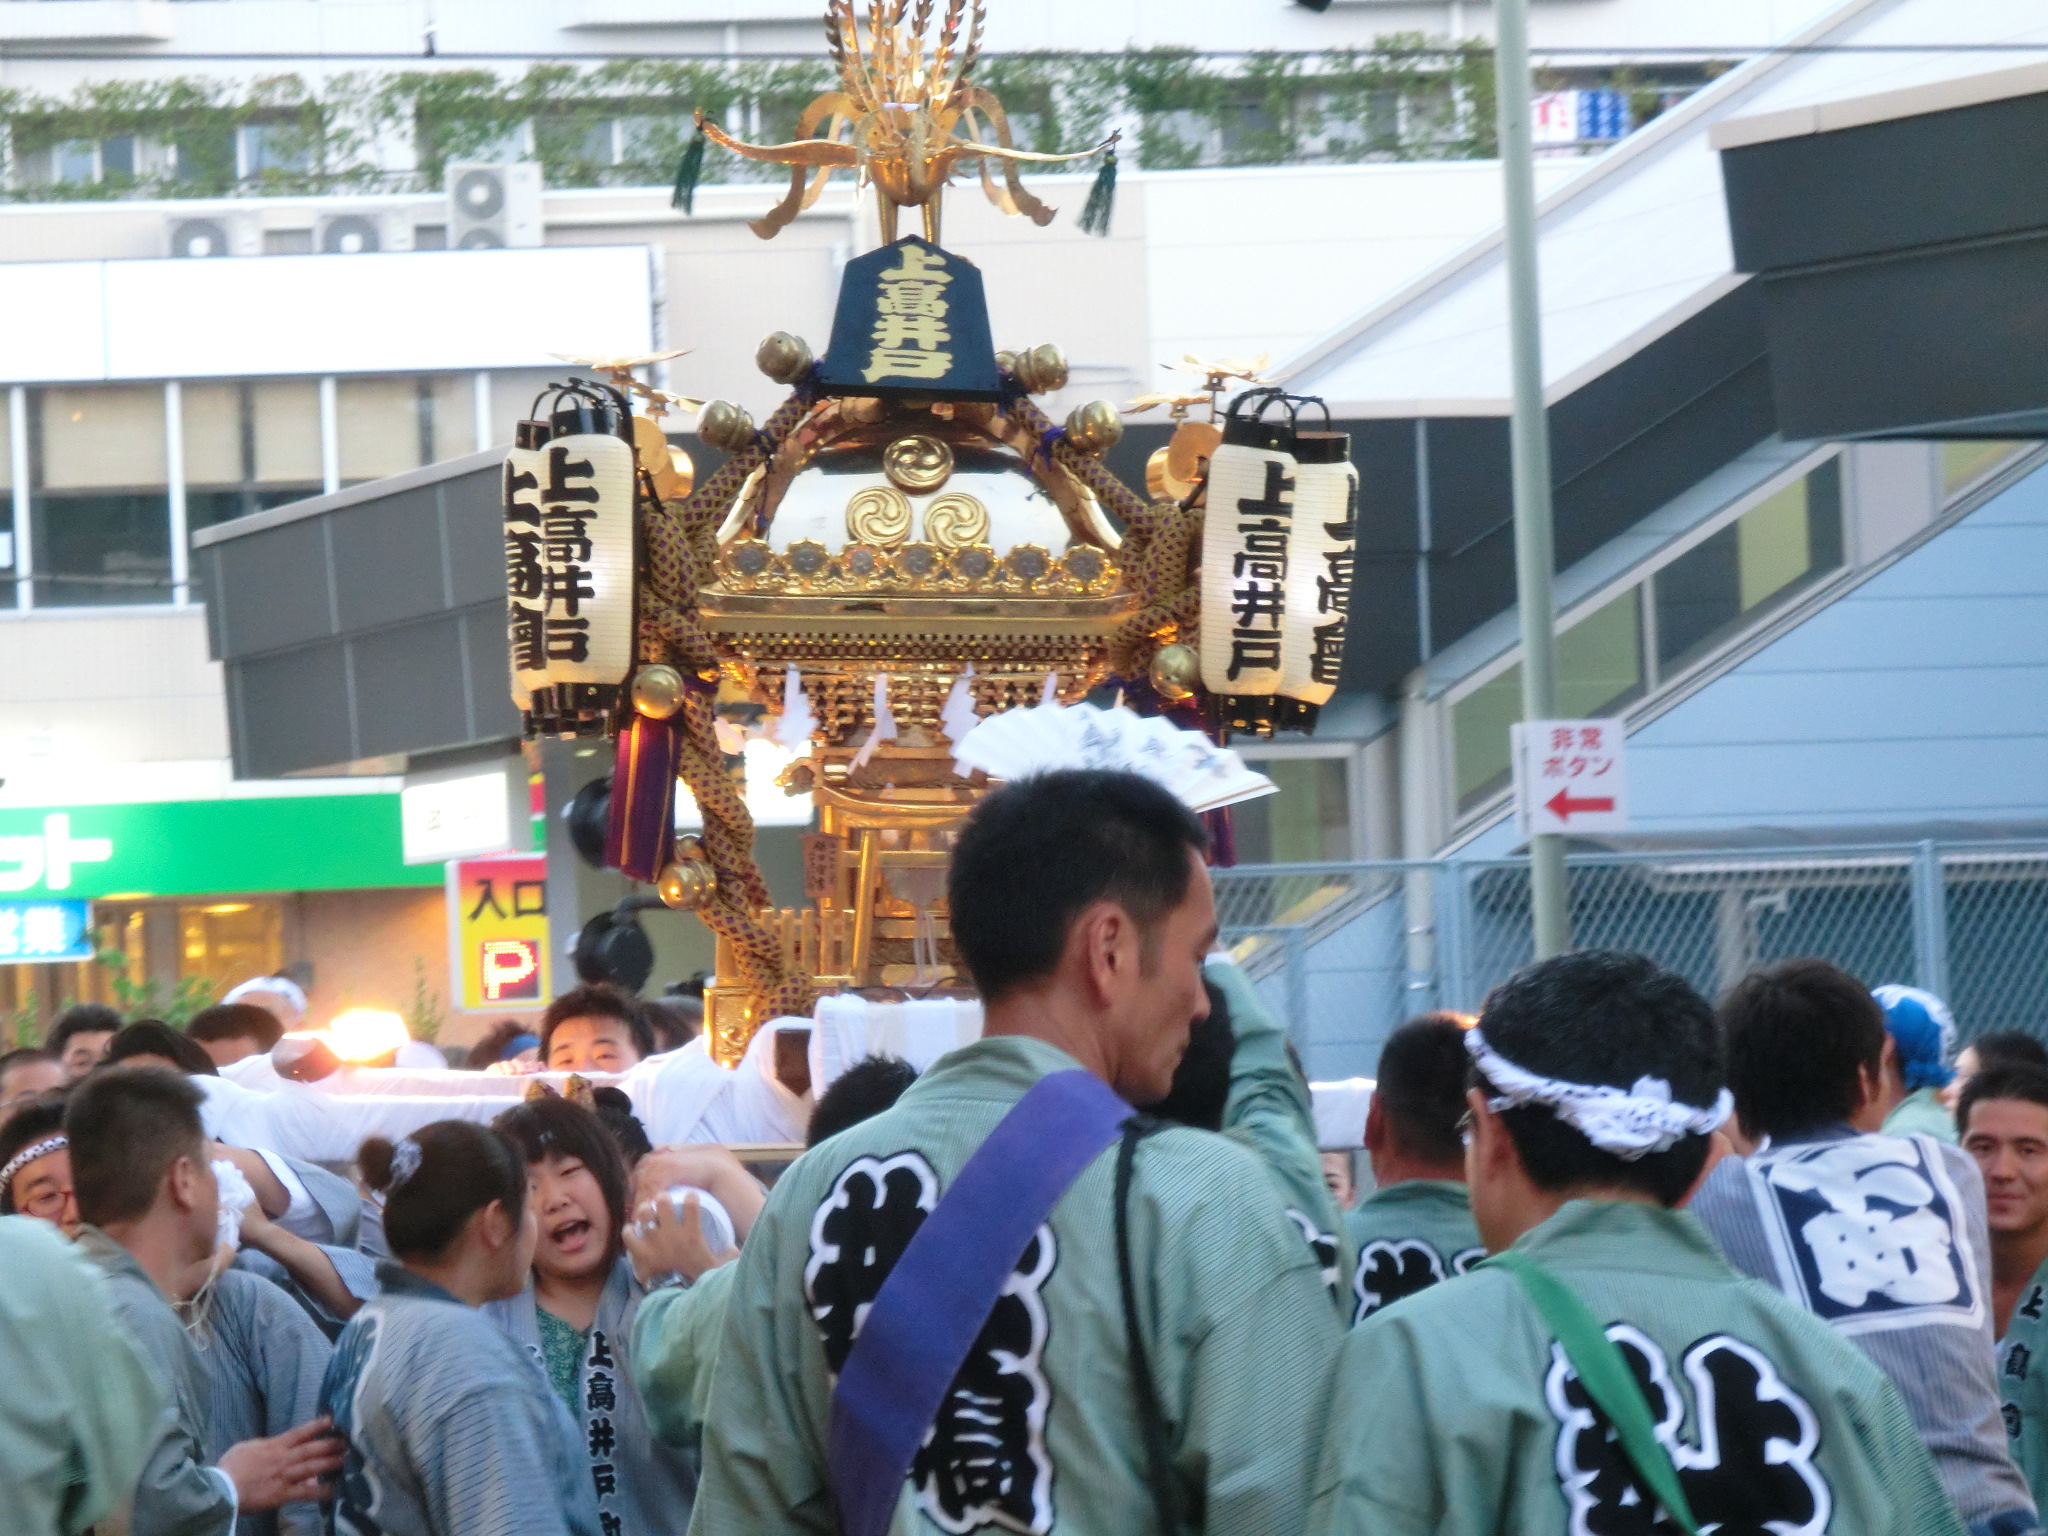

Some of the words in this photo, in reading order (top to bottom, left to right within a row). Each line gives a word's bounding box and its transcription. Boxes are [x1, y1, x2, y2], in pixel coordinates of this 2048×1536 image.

[861, 244, 954, 383] 上高井戸
[541, 446, 599, 662] 上高井戸
[1227, 461, 1296, 682] 上高井戸
[1543, 757, 1614, 777] ボタン
[470, 878, 547, 919] 入口
[484, 941, 539, 1000] P
